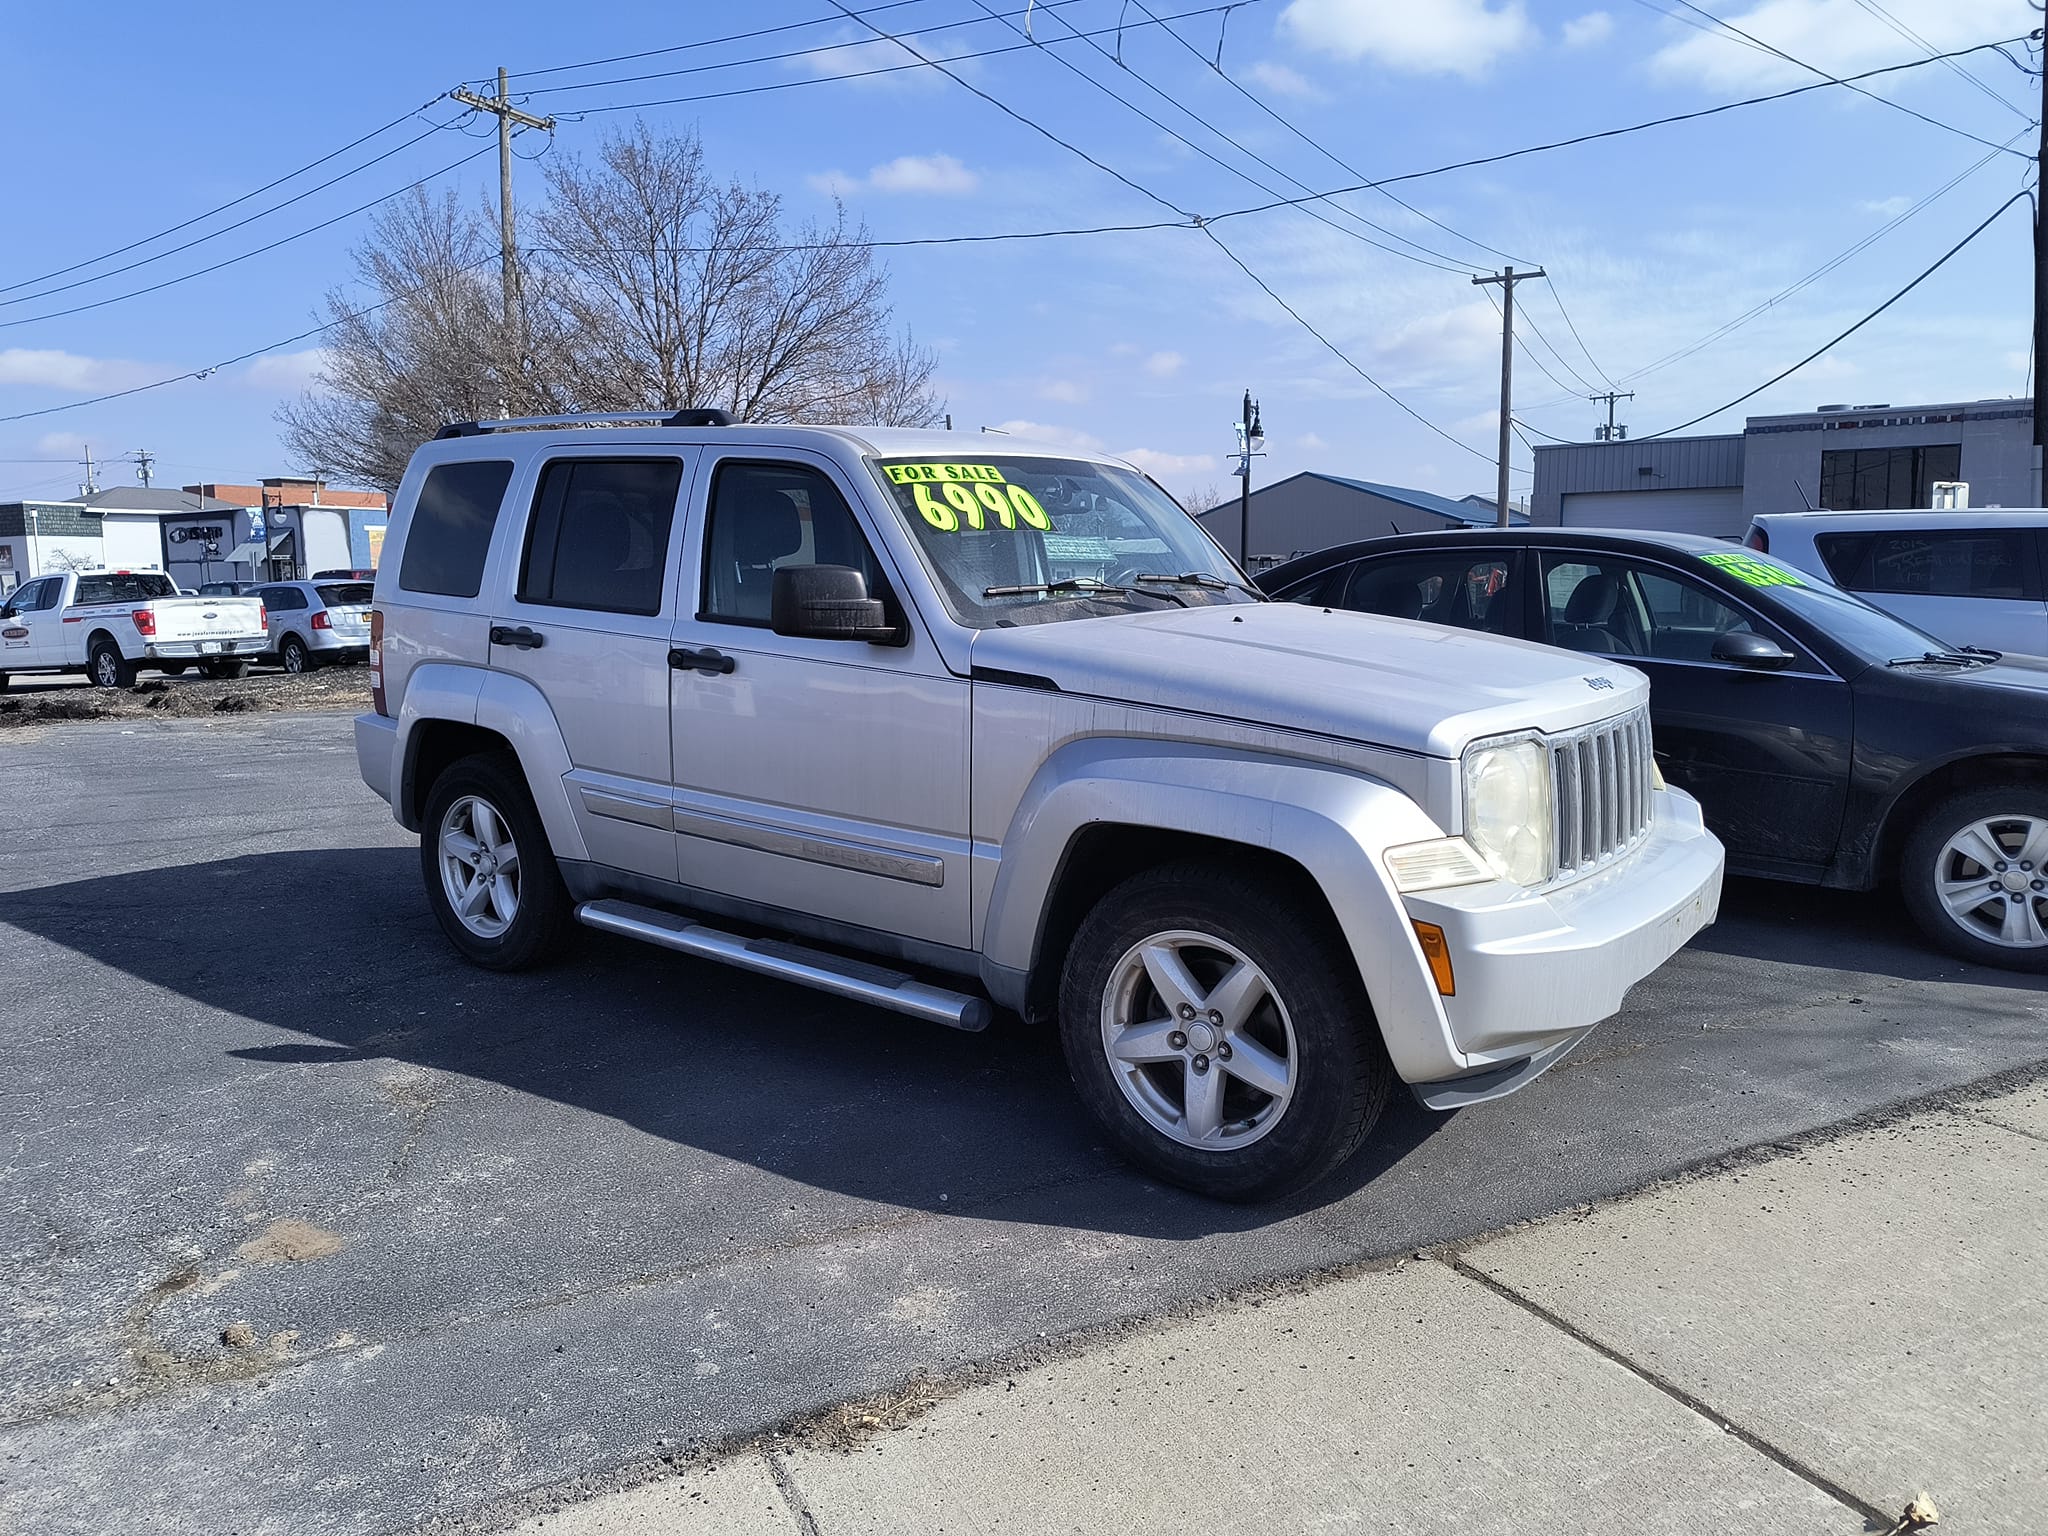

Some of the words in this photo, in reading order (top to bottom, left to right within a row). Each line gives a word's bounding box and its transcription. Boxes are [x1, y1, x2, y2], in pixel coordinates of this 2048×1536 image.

[889, 466, 935, 481] FOR
[945, 465, 999, 480] SALE
[912, 482, 1052, 532] 6990
[1583, 676, 1614, 691] Jeep
[801, 841, 915, 873] LIBERTY
